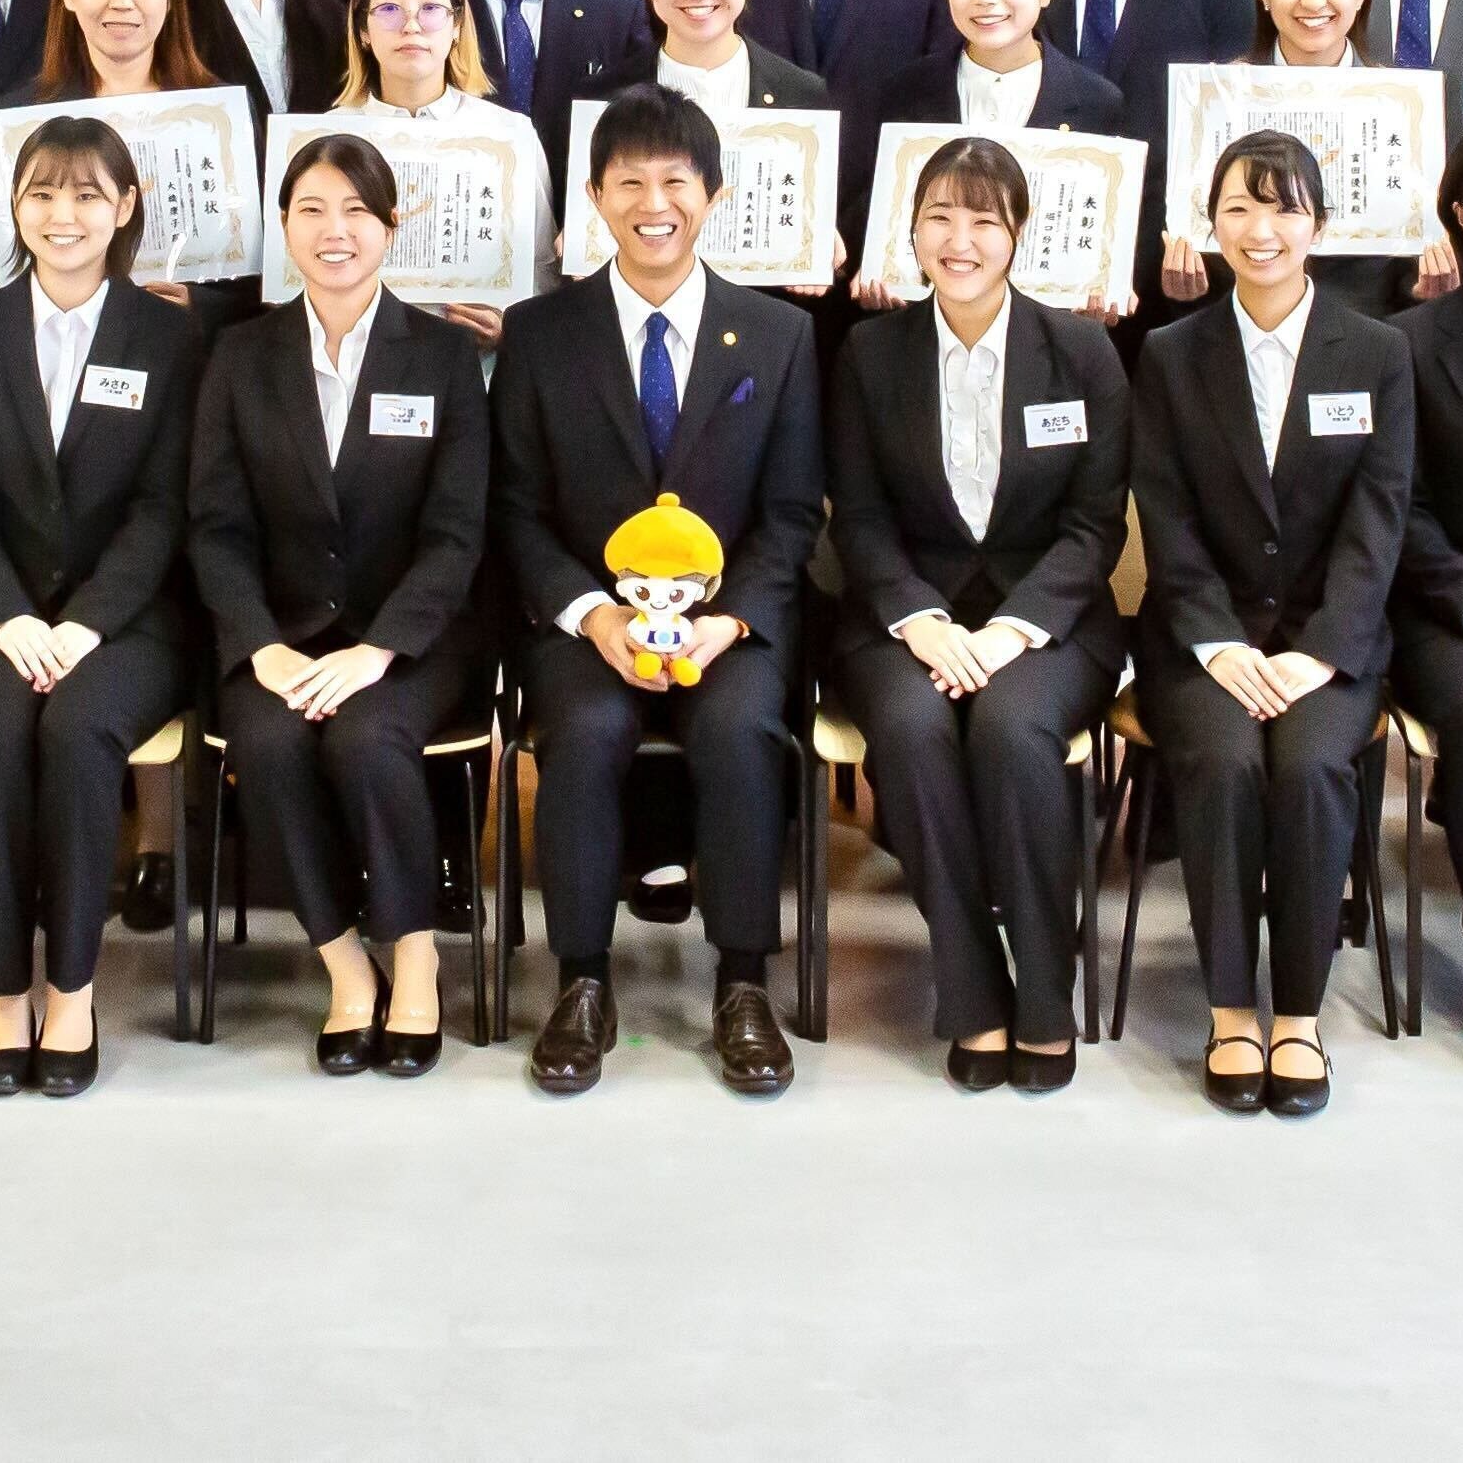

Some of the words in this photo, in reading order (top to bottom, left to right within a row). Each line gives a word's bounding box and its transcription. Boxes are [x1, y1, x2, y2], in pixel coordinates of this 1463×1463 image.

[198, 156, 219, 215] 表彰状
[778, 173, 796, 228] 表彰状
[477, 186, 494, 241] 表彰状
[1077, 195, 1097, 250] 表彰状
[100, 377, 130, 391] みさわ
[1326, 405, 1355, 417] いとう
[1041, 415, 1071, 429] あだち
